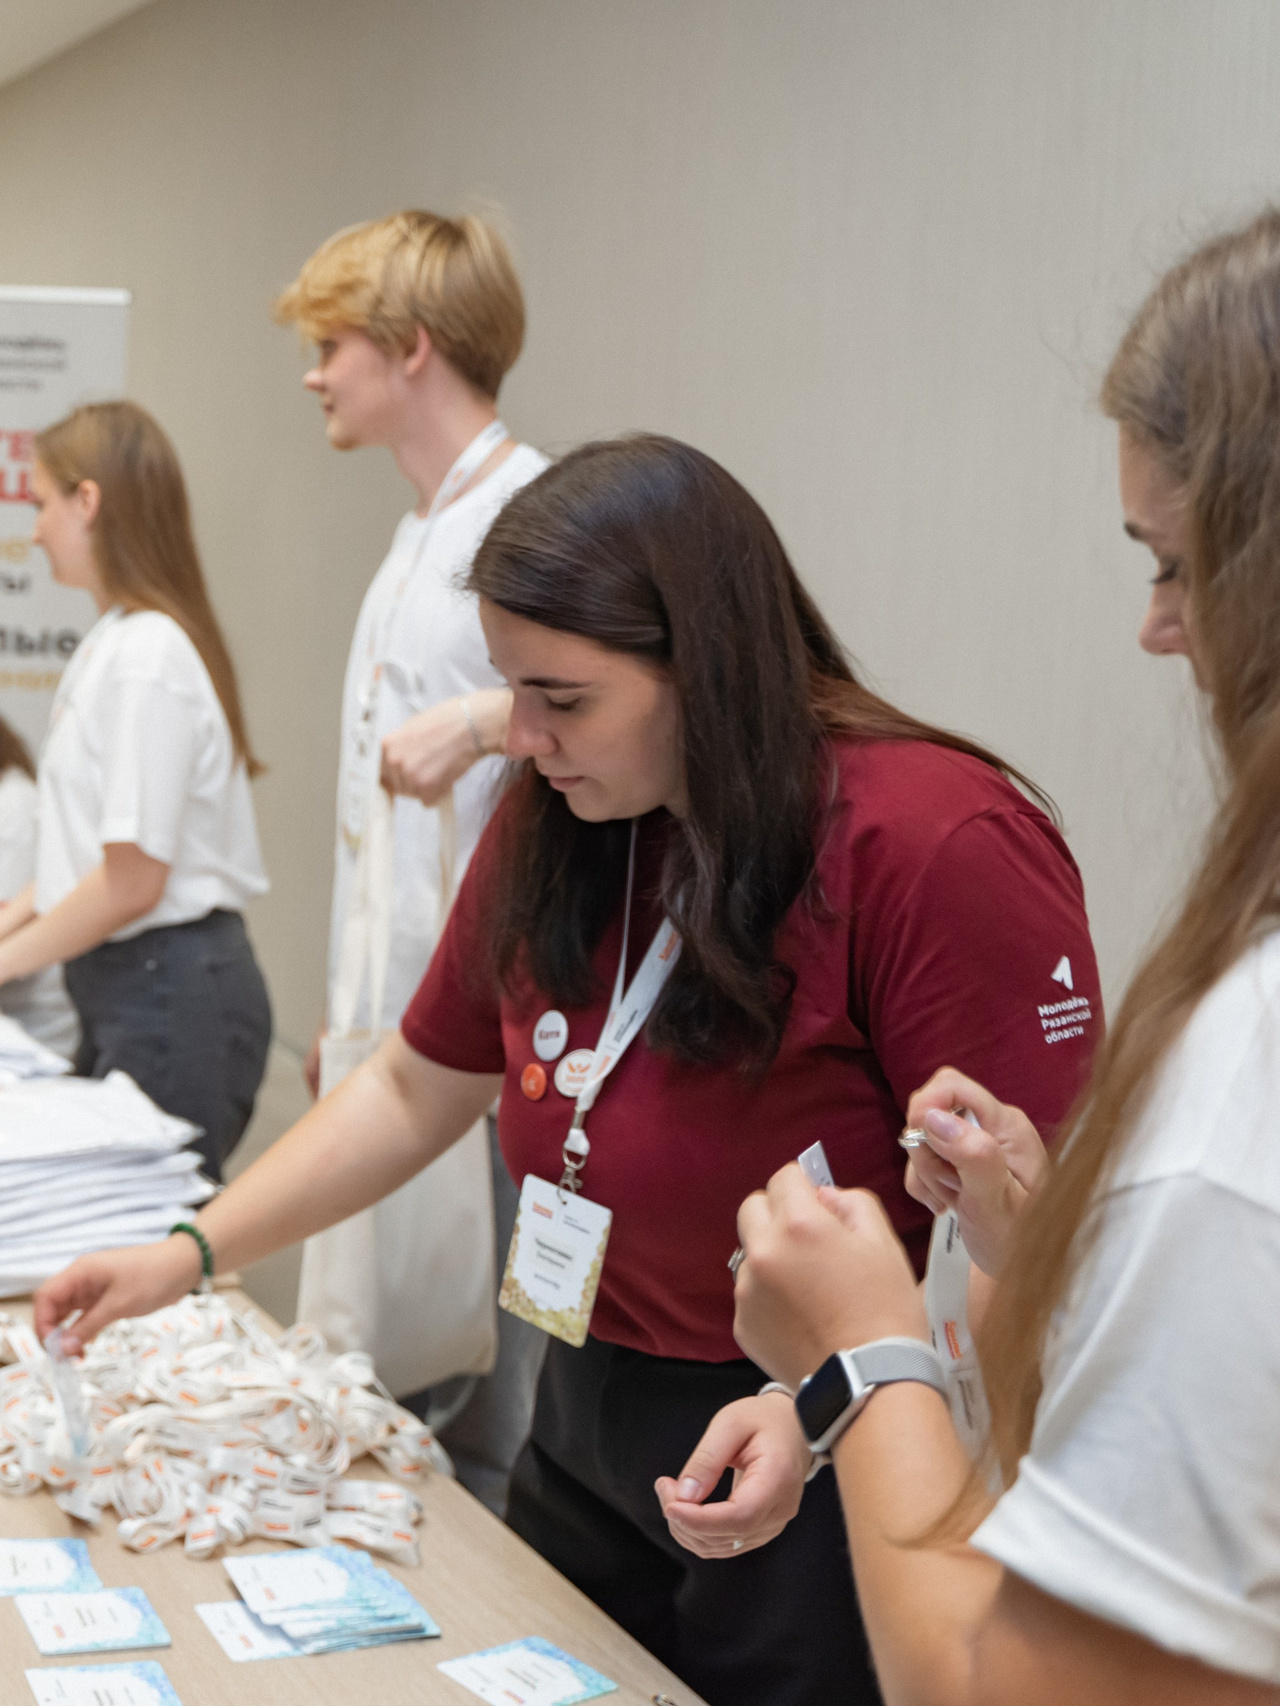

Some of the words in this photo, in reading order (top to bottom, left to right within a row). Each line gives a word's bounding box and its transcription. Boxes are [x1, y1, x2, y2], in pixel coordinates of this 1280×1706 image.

[1037, 996, 1089, 1017] Молодёжь
[1040, 1008, 1092, 1031] Рязанской
[1045, 1025, 1084, 1044] области
